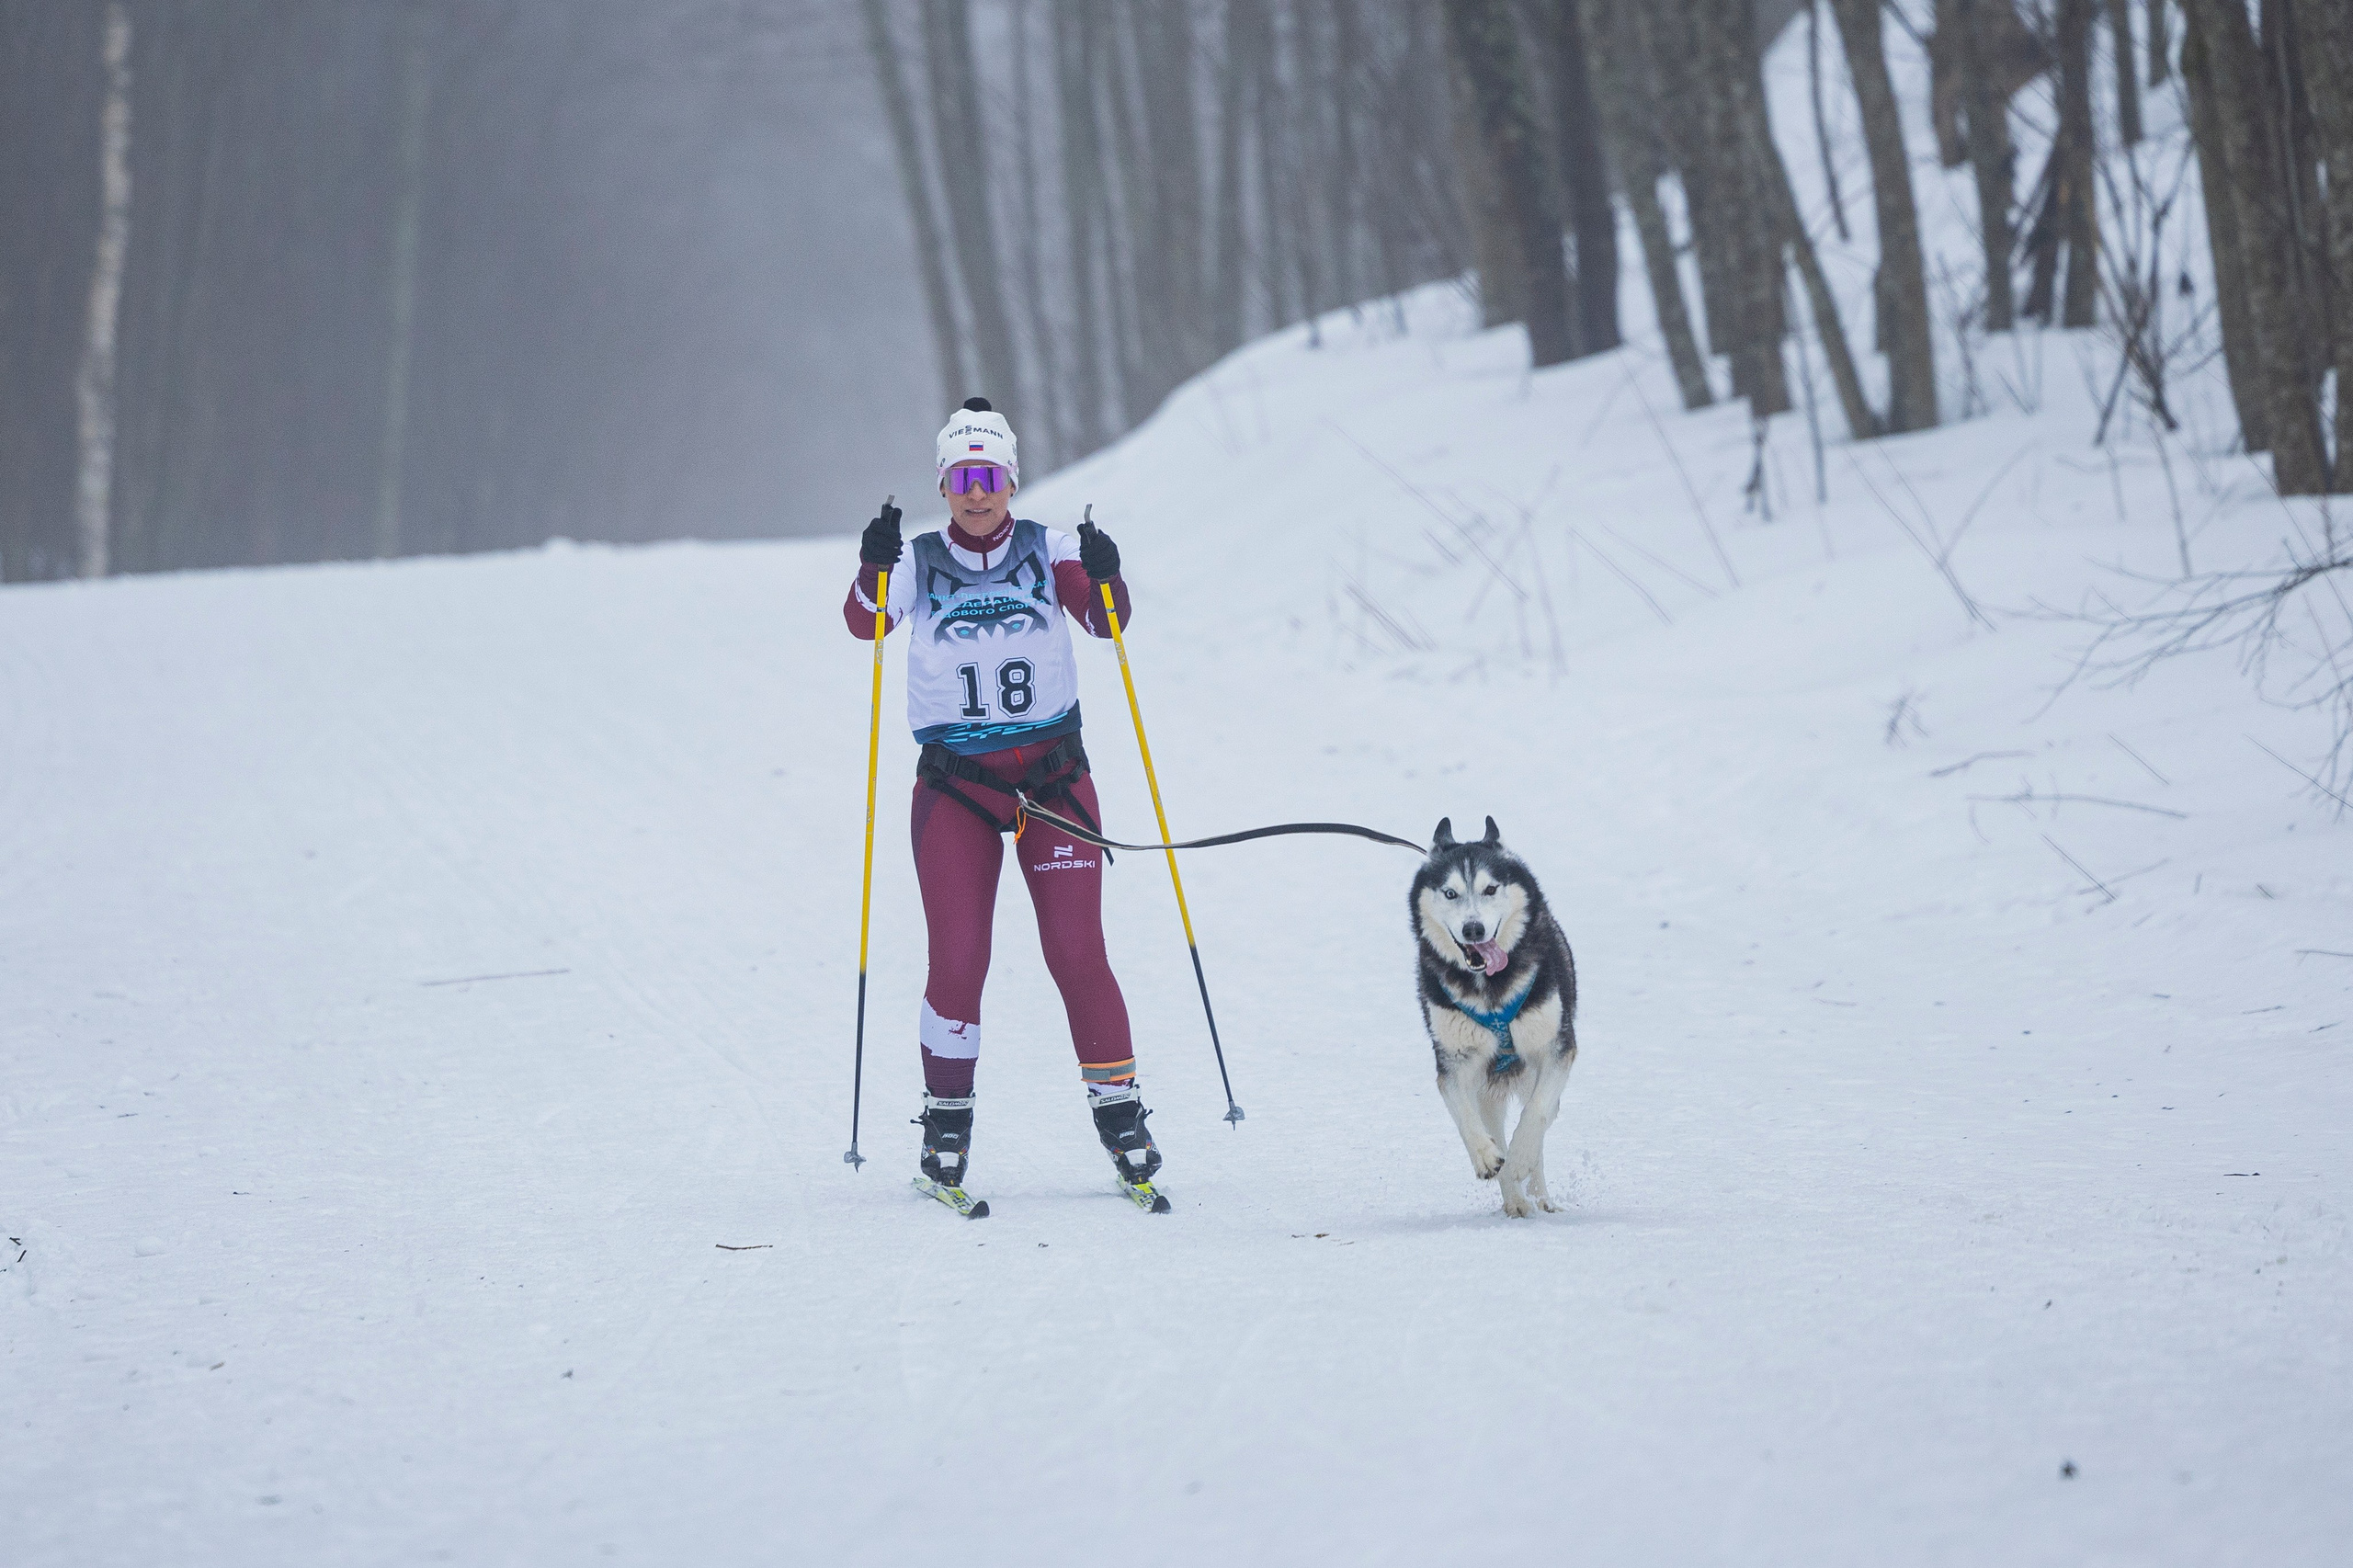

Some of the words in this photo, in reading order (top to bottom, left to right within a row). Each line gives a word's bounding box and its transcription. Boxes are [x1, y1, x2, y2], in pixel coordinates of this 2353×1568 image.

[949, 425, 1004, 439] VIESSMANN
[956, 656, 1037, 720] 18
[1033, 859, 1096, 872] NORDSKI
